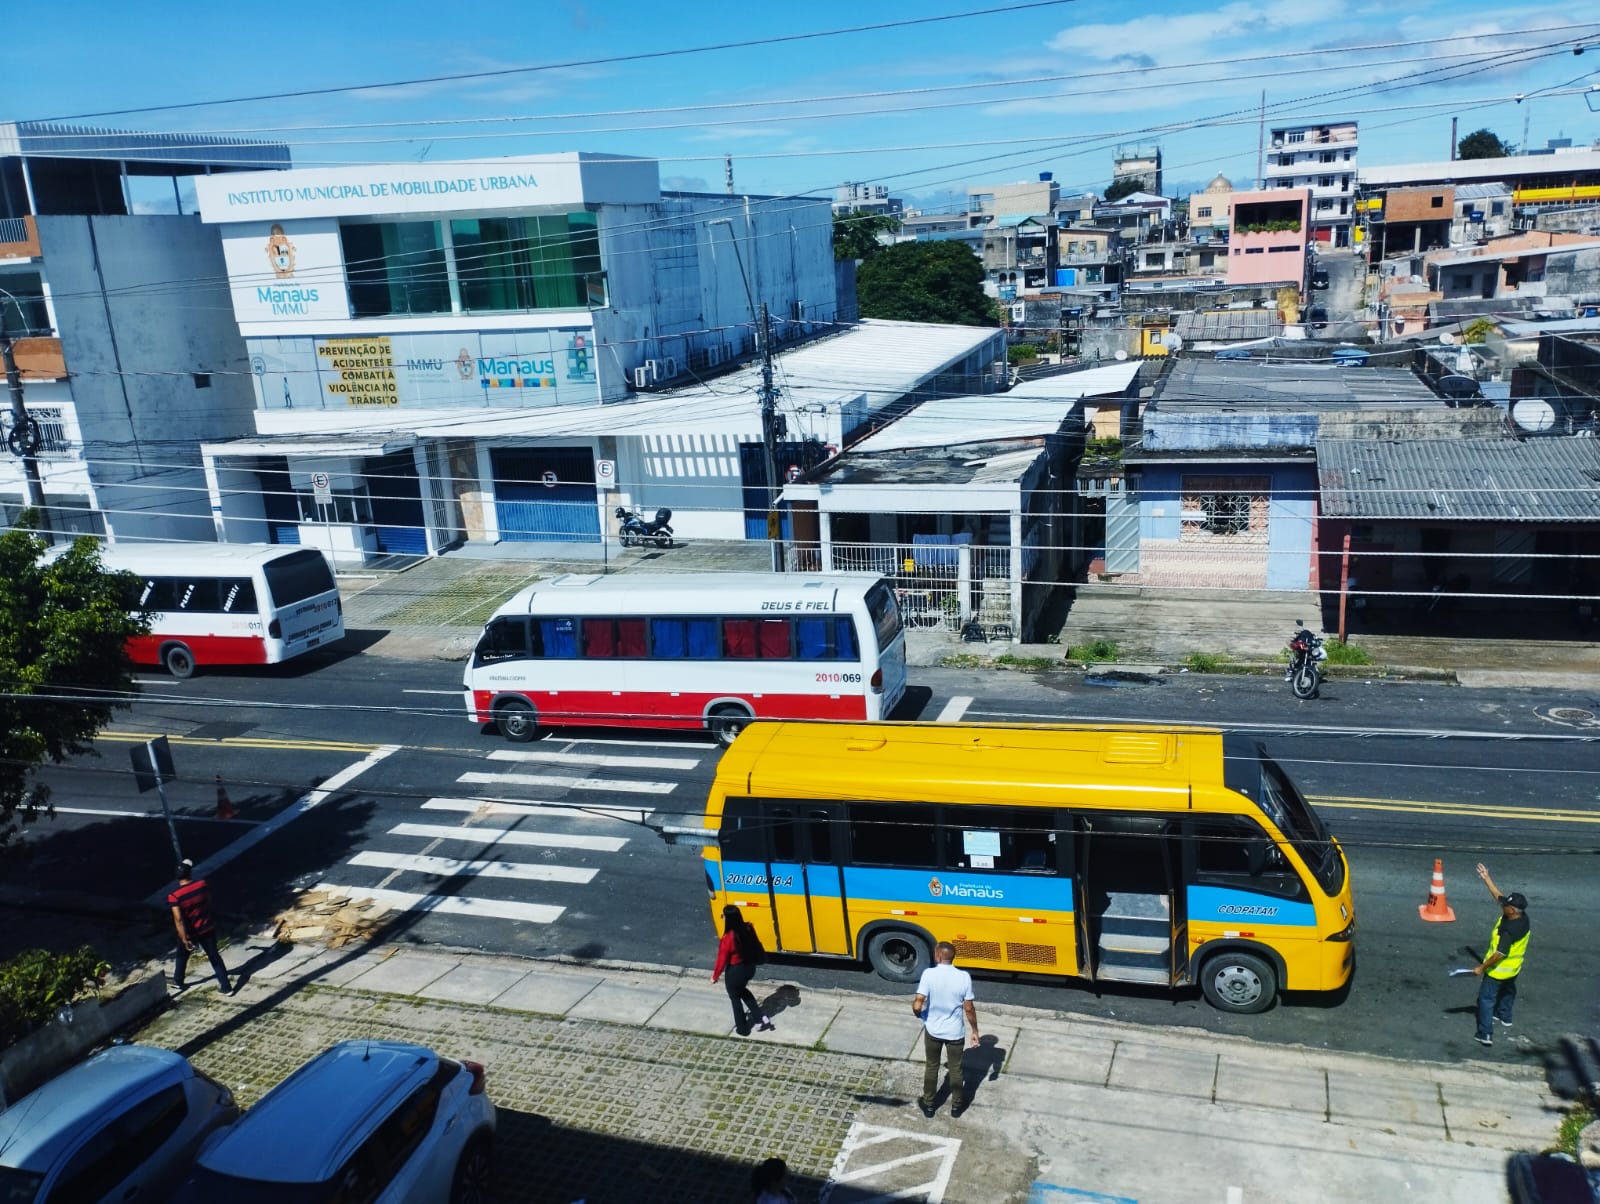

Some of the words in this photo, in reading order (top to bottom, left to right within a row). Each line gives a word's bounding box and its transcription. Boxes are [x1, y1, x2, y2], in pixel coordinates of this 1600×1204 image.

[228, 188, 294, 205] INSTITUTO
[297, 185, 368, 201] MUNICIPAL
[370, 183, 389, 197] DE
[391, 178, 477, 196] MOBILIDADE
[480, 174, 538, 191] URBANA
[257, 287, 319, 303] Manaus
[272, 303, 309, 316] IMMU
[319, 344, 377, 357] PREVENÇÃO
[379, 345, 391, 354] DE
[333, 359, 385, 368] ACIDENTES
[406, 359, 443, 371] IMMU
[478, 358, 555, 376] Manaus
[329, 382, 381, 393] VIOLÊNCIA
[351, 394, 398, 405] TRÂNSITO
[761, 601, 792, 610] DEUS
[806, 601, 829, 610] FIEL
[816, 673, 861, 683] 2010/069
[945, 885, 1004, 899] Manaus
[1217, 905, 1279, 916] COOPATAM
